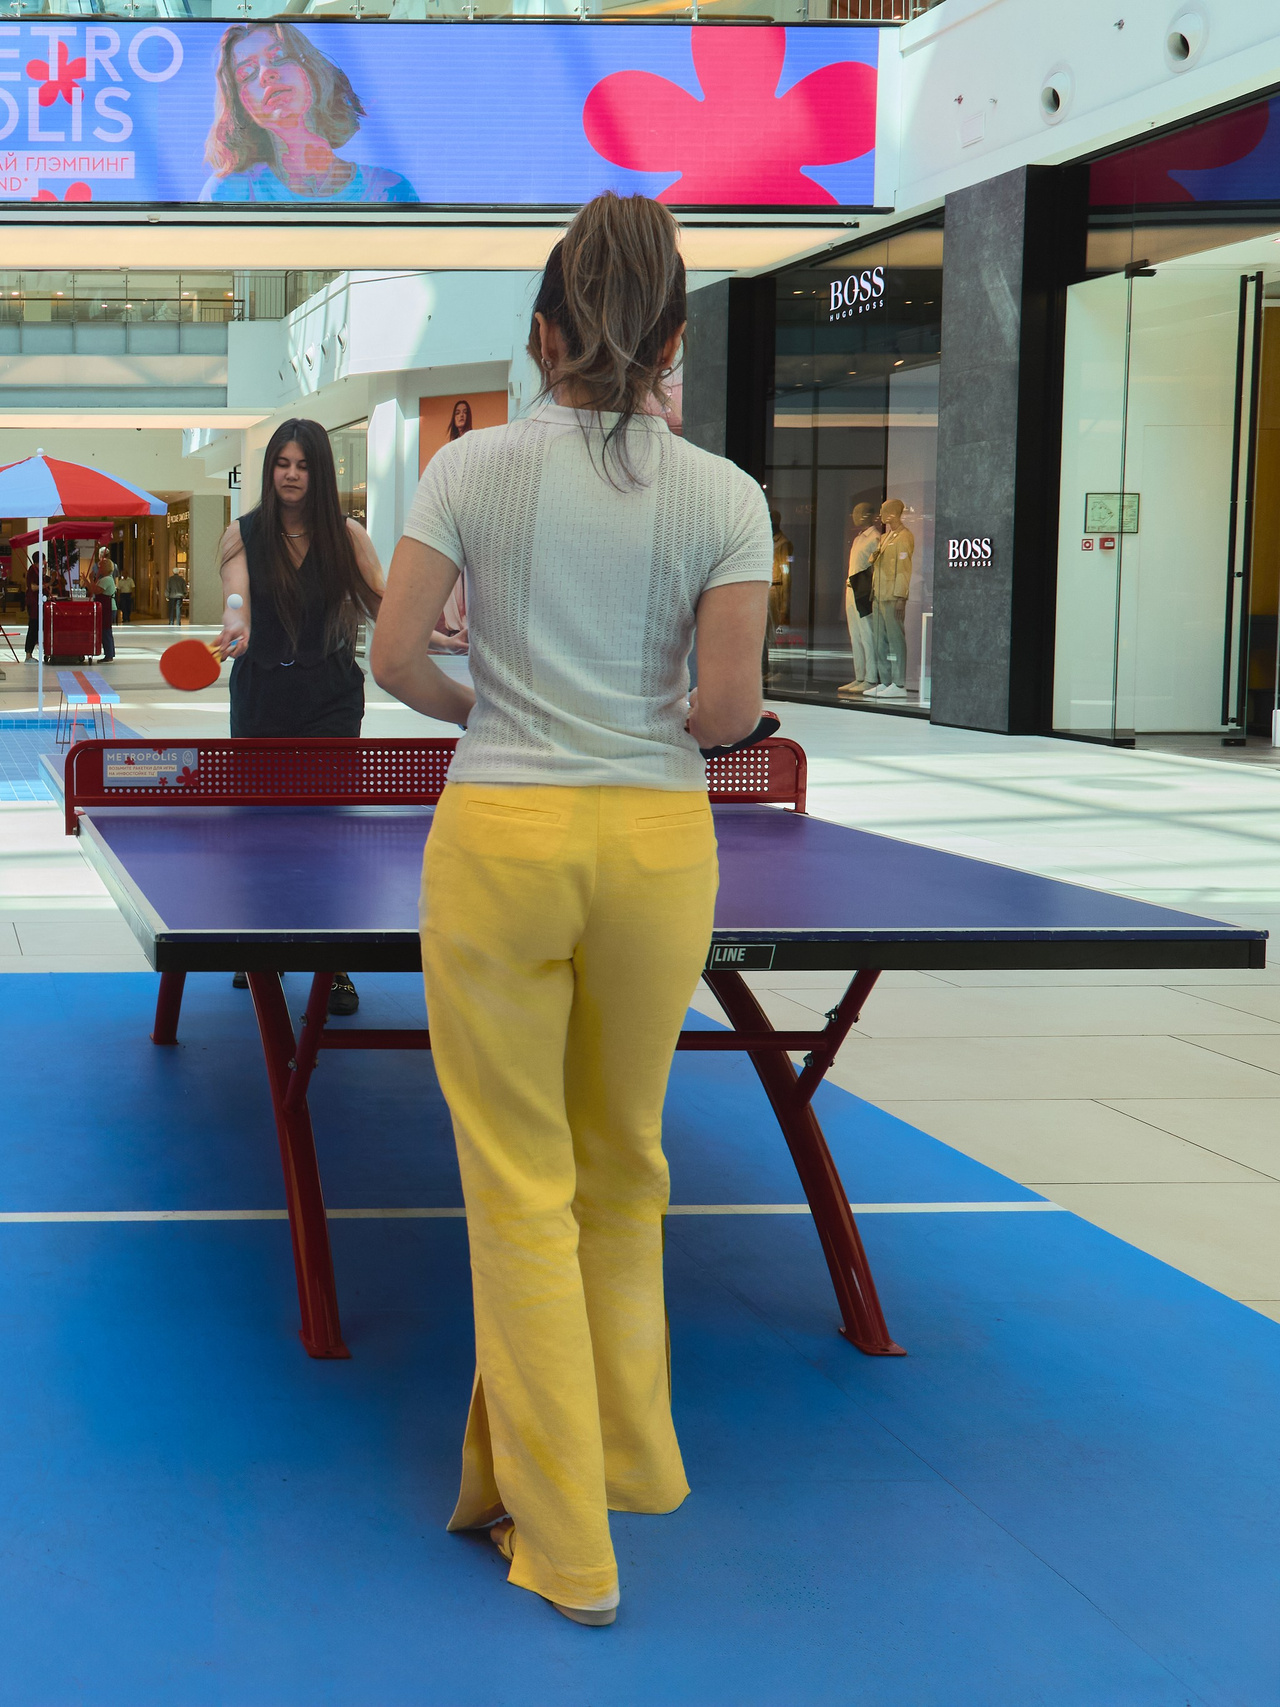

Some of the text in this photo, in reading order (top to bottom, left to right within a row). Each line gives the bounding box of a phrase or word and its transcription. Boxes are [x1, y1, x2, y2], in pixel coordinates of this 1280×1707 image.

[26, 156, 129, 172] ГЛЭМПИНГ
[830, 266, 885, 311] BOSS
[829, 300, 884, 322] HUGO BOSS
[948, 538, 992, 559] BOSS
[107, 753, 178, 761] METROPOLIS
[715, 948, 746, 962] LINE
